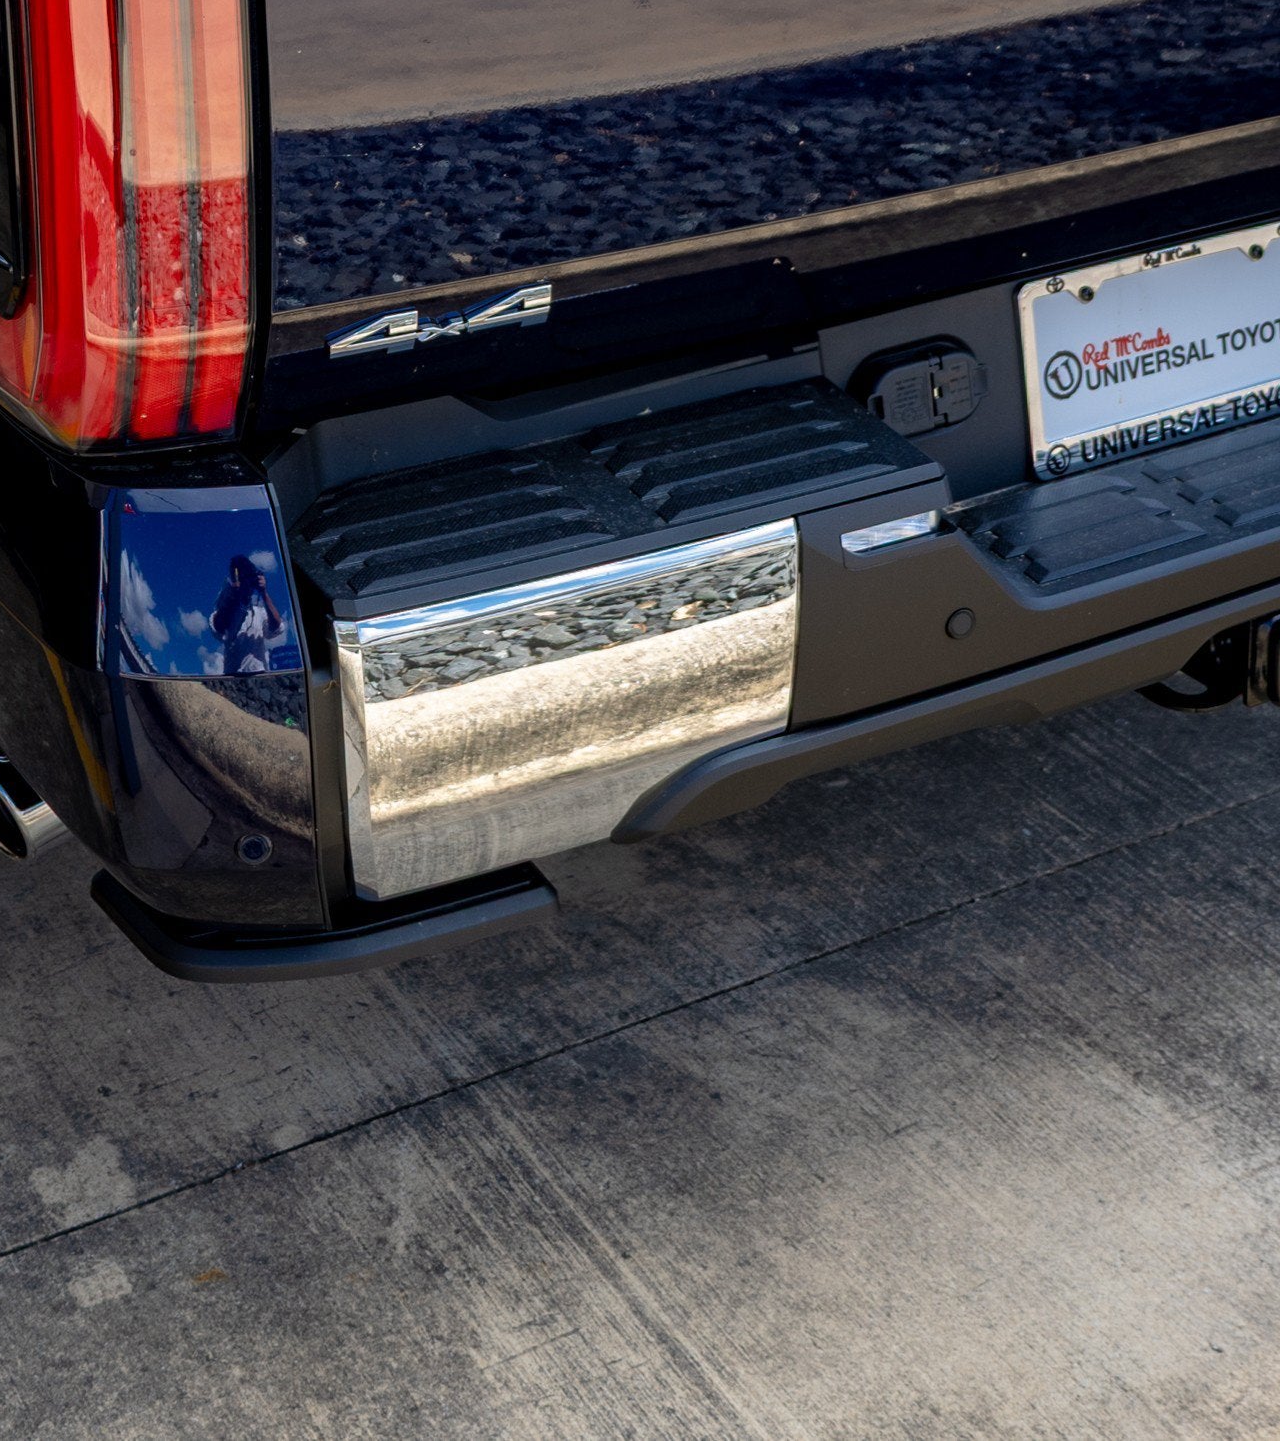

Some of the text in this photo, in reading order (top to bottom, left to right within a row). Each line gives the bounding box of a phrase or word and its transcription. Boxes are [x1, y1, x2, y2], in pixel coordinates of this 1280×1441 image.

[1082, 327, 1171, 370] Red McCombs
[1085, 338, 1215, 391] UNIVERSAL
[1079, 408, 1225, 463] UNIVERSAL
